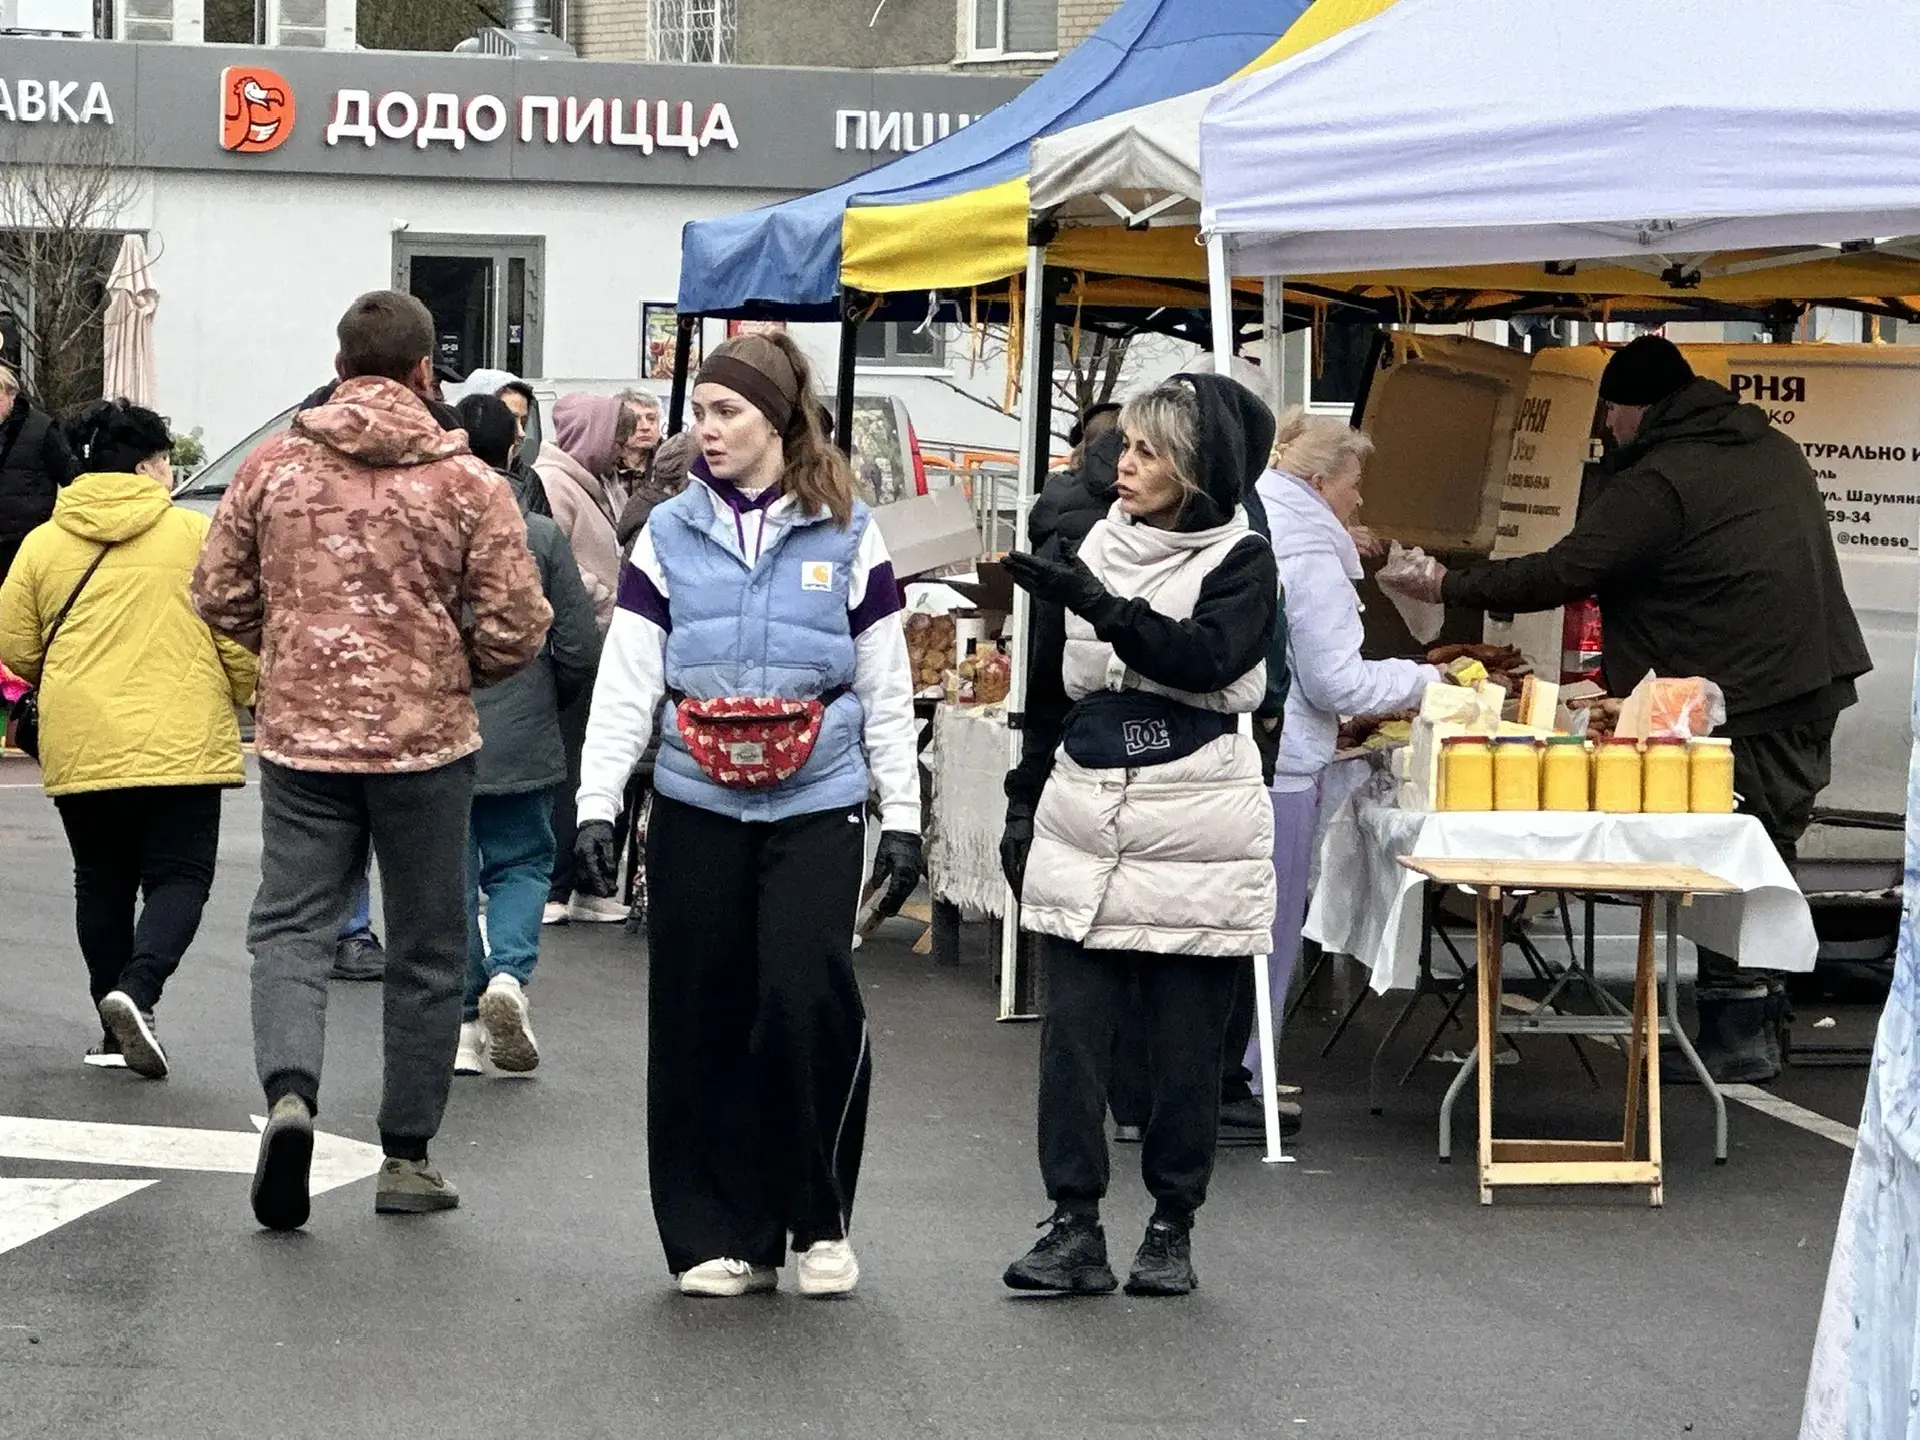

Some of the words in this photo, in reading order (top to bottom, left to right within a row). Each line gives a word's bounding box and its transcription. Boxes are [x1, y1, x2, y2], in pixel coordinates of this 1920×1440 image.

[325, 88, 508, 150] ДОДО
[519, 94, 740, 157] ПИЦЦА
[1796, 442, 1906, 461] ТУРАЛЬНО
